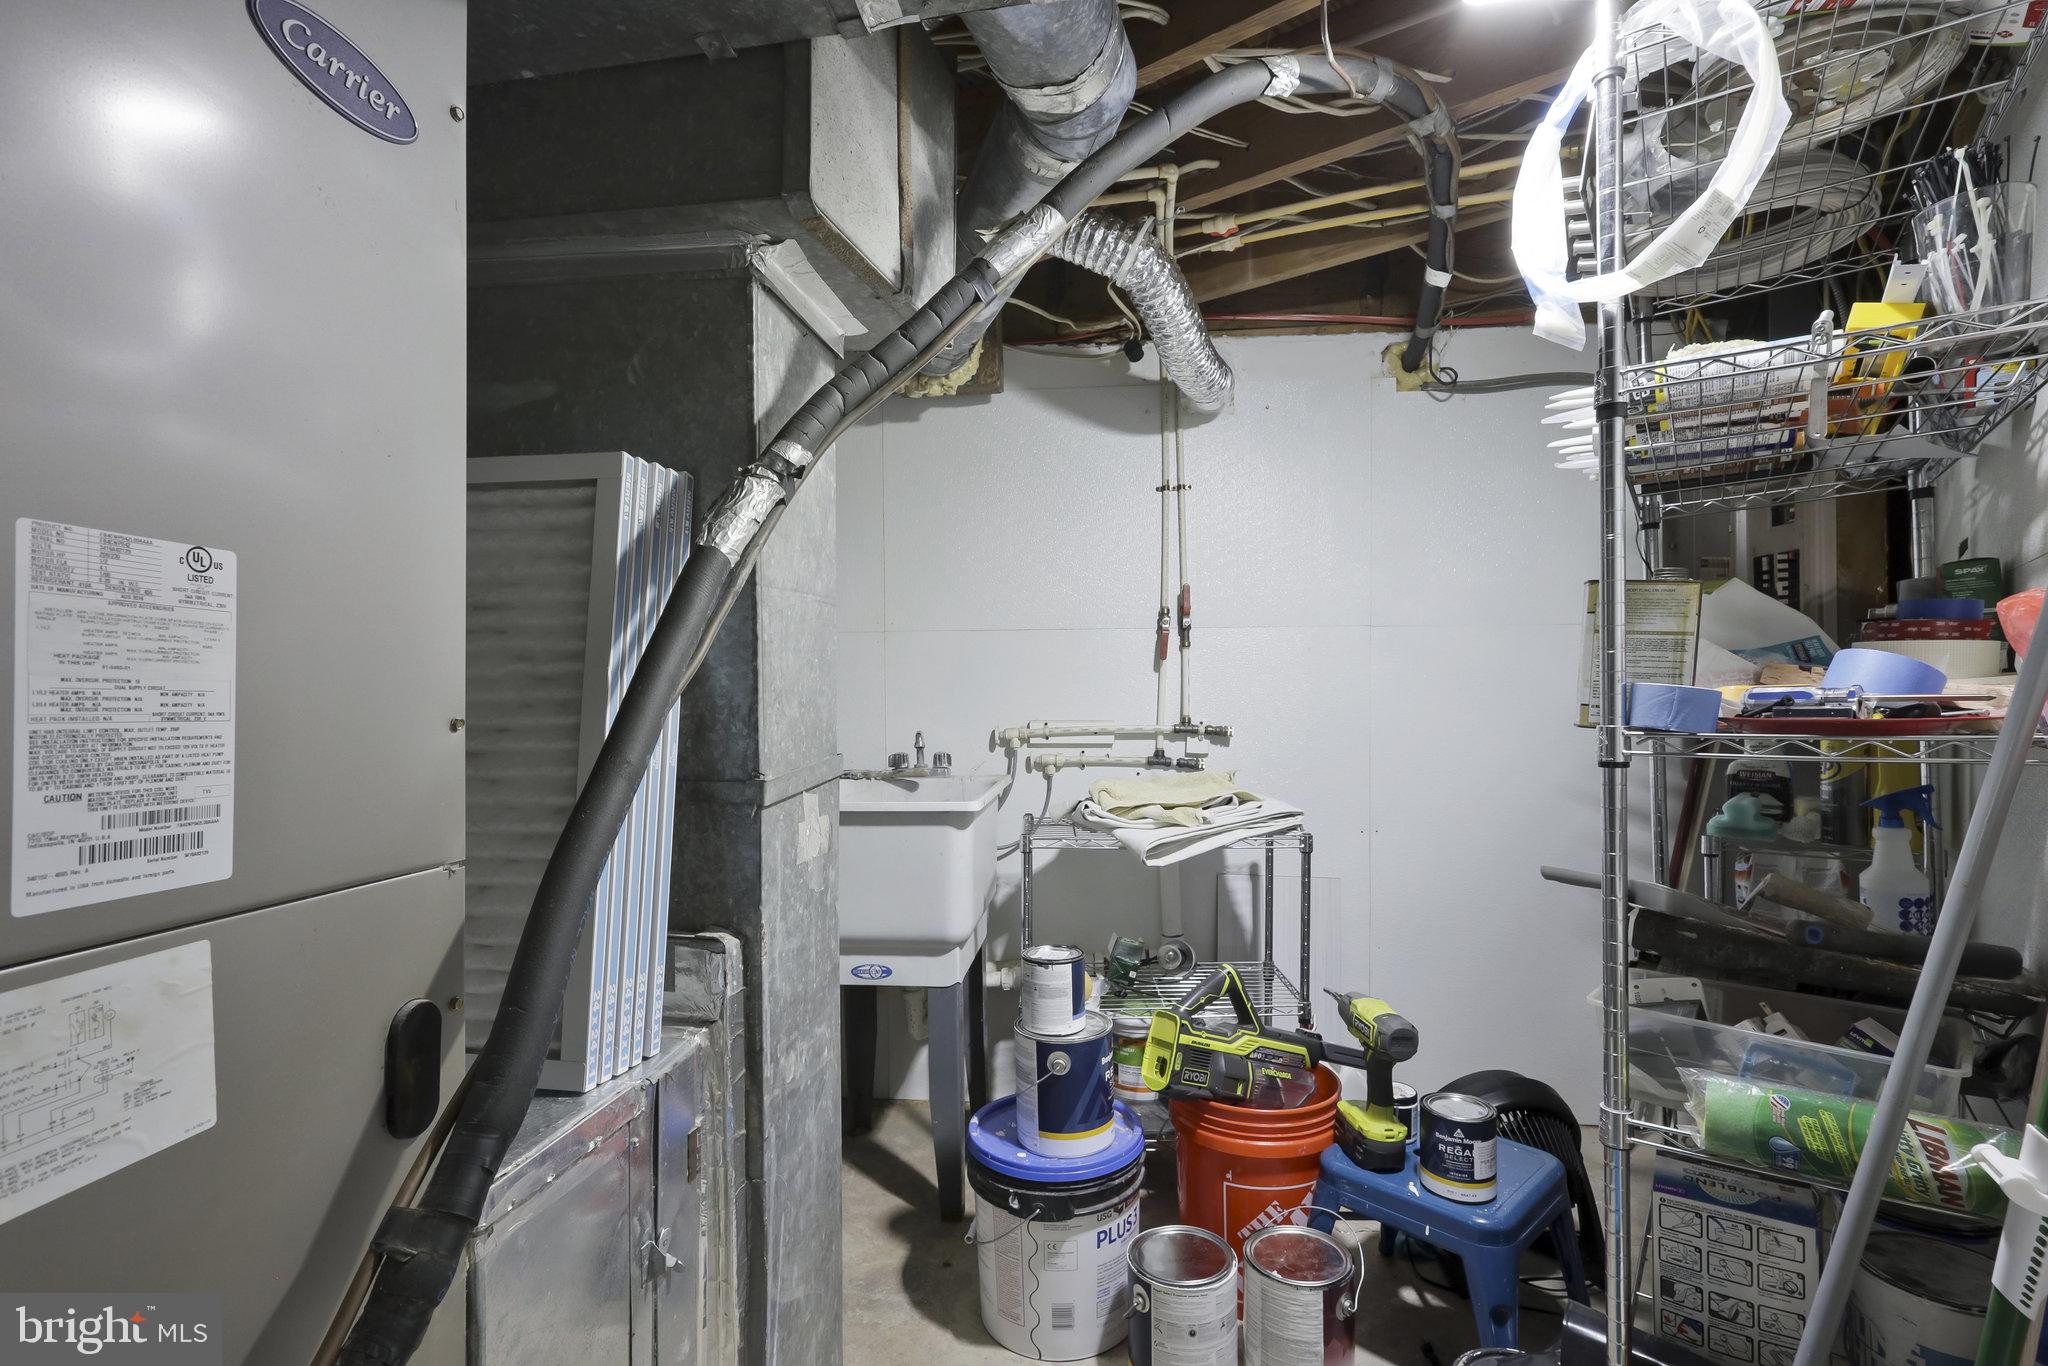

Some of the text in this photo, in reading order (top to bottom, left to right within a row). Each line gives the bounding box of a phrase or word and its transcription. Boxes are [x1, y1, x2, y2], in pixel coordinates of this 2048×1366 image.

[282, 19, 401, 120] Carrier
[179, 557, 185, 565] C
[213, 562, 223, 570] US
[1954, 565, 1986, 575] SPAX
[187, 574, 214, 584] LISTED
[638, 972, 646, 992] 24
[656, 965, 664, 984] 24
[608, 984, 616, 1004] 24
[624, 978, 632, 997] 24
[593, 991, 601, 1012] 24
[655, 1000, 662, 1018] 24
[623, 1015, 631, 1034] 24
[636, 1009, 644, 1028] 24
[591, 1029, 599, 1050] 24
[606, 1021, 614, 1042] 24
[1184, 1071, 1206, 1083] RYOBI
[1435, 1131, 1462, 1144] Benjamin
[1438, 1143, 1474, 1157] REGA
[1445, 1153, 1474, 1162] SELECT
[1907, 1118, 1966, 1208] LIBMAN
[1096, 1210, 1113, 1221] USG
[1097, 1213, 1132, 1249] PLUS
